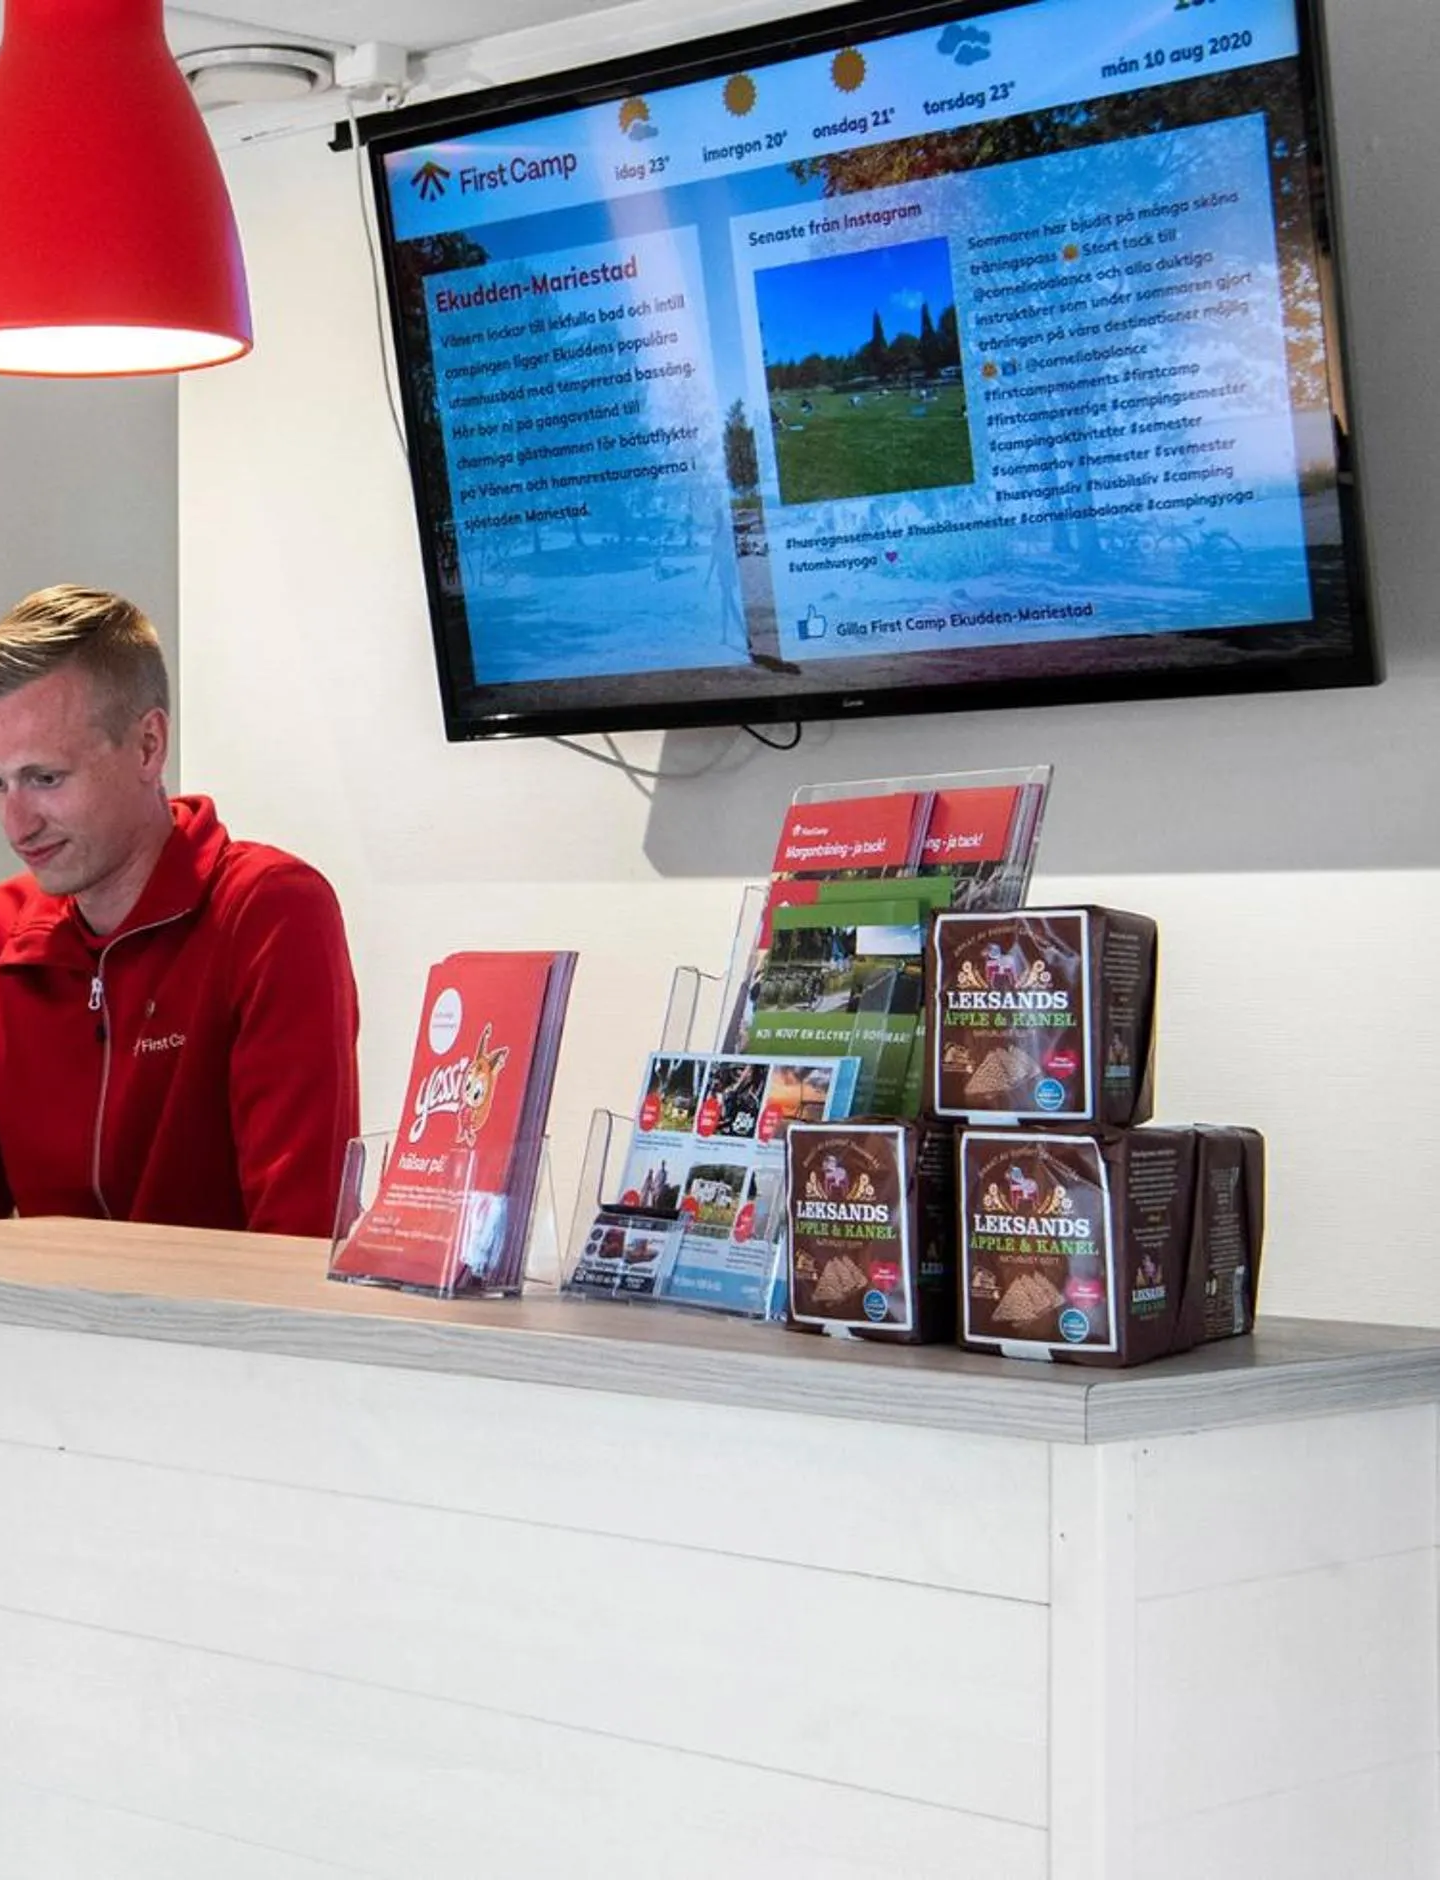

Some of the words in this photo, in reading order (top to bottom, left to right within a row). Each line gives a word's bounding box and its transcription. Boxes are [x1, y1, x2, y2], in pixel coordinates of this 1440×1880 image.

[1100, 55, 1139, 78] mån
[1143, 48, 1165, 69] 10
[1168, 43, 1204, 63] aug
[1207, 29, 1253, 55] 2020
[922, 91, 986, 115] torsdag
[812, 116, 868, 138] onsdag
[702, 138, 761, 162] imorgon
[458, 160, 507, 196] First
[509, 151, 578, 183] Camp
[614, 163, 646, 180] idag
[748, 223, 806, 247] Senaste
[808, 216, 840, 236] från
[843, 203, 922, 229] Instagram
[967, 227, 1040, 249] Sommaren
[1042, 222, 1066, 236] har
[1069, 211, 1112, 233] bjudit
[1082, 237, 1117, 255] Stort
[1122, 231, 1153, 248] tack
[1157, 227, 1177, 242] till
[1095, 265, 1120, 280] och
[1125, 261, 1151, 275] alla
[1156, 252, 1213, 270] duktiga
[435, 253, 638, 314] Ekudden-Mariestad
[1060, 300, 1086, 313] som
[1091, 292, 1132, 308] under
[1135, 279, 1212, 301] sommaren
[1216, 270, 1251, 292] gjort
[528, 317, 545, 334] till
[598, 303, 624, 322] bad
[627, 299, 651, 317] och
[654, 292, 685, 312] intill
[1103, 308, 1198, 332] destinationer
[444, 360, 512, 380] campingen
[552, 342, 614, 362] Ekuddens
[1121, 363, 1199, 382] #firstcamp
[526, 381, 553, 398] med
[622, 398, 639, 414] till
[526, 476, 548, 492] och
[1162, 464, 1233, 482] #camping
[1146, 489, 1254, 510] #campingyoga
[836, 621, 867, 637] Gilla
[870, 617, 901, 634] First
[905, 616, 946, 631] Camp
[949, 600, 1093, 629] Ekudden-Mariestad
[947, 991, 1069, 1010] LEKSANDS
[994, 1012, 1008, 1027] &
[1012, 1011, 1078, 1027] KANEL
[141, 1037, 168, 1053] First
[796, 1200, 889, 1223] LEKSANDS
[844, 1222, 896, 1240] KANEL
[973, 1214, 1091, 1238] LEKSANDS
[1019, 1238, 1032, 1253] &
[1036, 1239, 1099, 1256] KANEL
